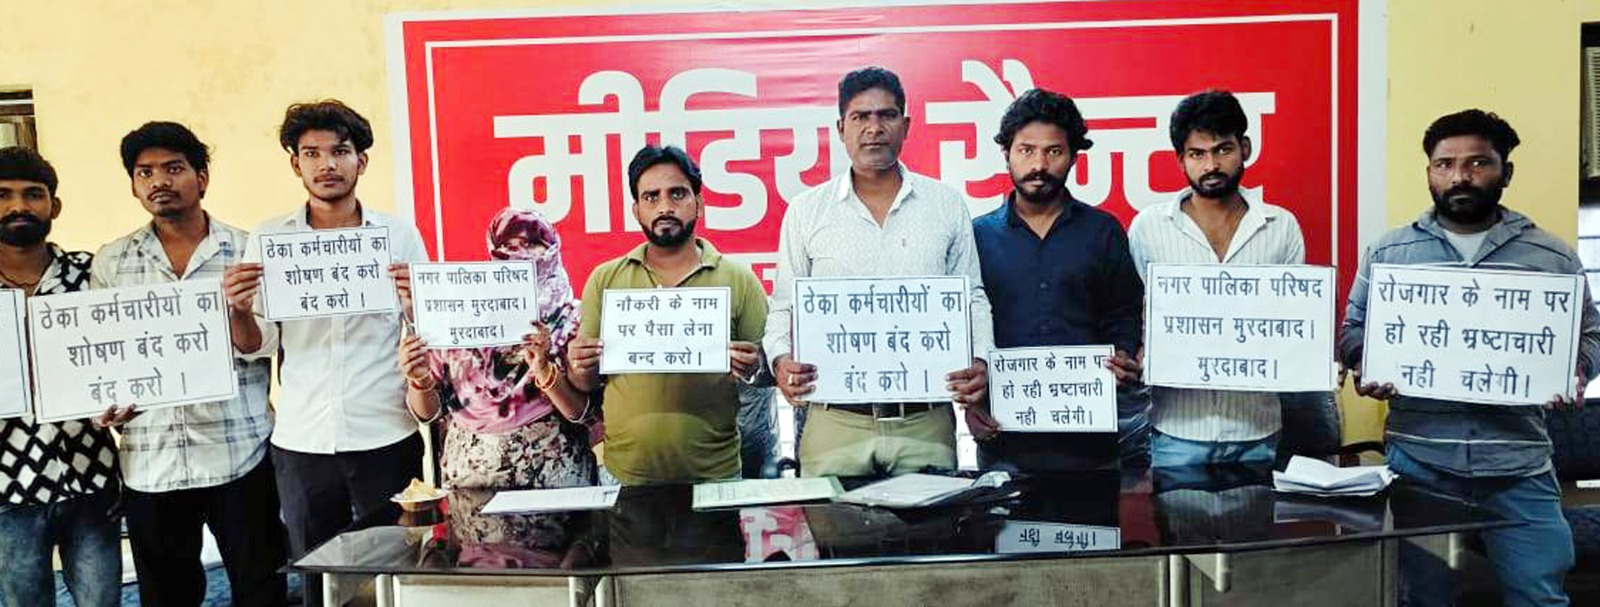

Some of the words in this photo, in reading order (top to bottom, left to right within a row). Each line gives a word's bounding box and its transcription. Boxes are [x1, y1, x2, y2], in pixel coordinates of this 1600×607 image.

[266, 239, 292, 258] ठेका
[300, 233, 362, 256] कर्मचारीयों
[370, 237, 386, 251] का
[284, 264, 323, 285] शोषण
[331, 263, 349, 282] बंद
[356, 258, 379, 279] करो
[418, 272, 439, 284] नगर
[447, 267, 486, 284] पालिका
[493, 266, 528, 283] परिषद
[1157, 276, 1191, 294] नगर
[1201, 271, 1260, 296] पालिका
[1270, 272, 1323, 298] परिषद
[300, 292, 318, 311] बंद
[325, 288, 348, 309] करो
[425, 299, 465, 314] प्रशासन
[617, 295, 660, 311] नौकरी
[669, 294, 682, 309] के
[691, 298, 718, 309] नाम
[803, 286, 838, 315] ठेका
[847, 284, 930, 314] कर्मचारीयों
[940, 291, 962, 312] का
[1378, 274, 1450, 305] रोजगार
[1462, 278, 1480, 307] के
[1494, 288, 1532, 310] नाम
[1544, 291, 1571, 313] पर
[40, 302, 78, 329] ठेका
[90, 288, 182, 324] कर्मचारीयों
[195, 291, 218, 312] का
[618, 325, 636, 336] पर
[645, 320, 674, 336] पैसा
[683, 319, 713, 336] लेना
[827, 324, 877, 353] शोषण
[886, 325, 910, 353] बंद
[920, 322, 951, 351] करो
[1164, 316, 1223, 335] प्रशासन
[1384, 315, 1405, 344] हो
[1418, 319, 1451, 348] रही
[67, 336, 125, 366] शोषण
[135, 331, 163, 358] बंद
[173, 323, 208, 353] करो
[628, 352, 655, 365] बन्द
[994, 355, 1038, 373] रोजगार
[1045, 352, 1056, 370] के
[1064, 356, 1086, 370] नाम
[89, 376, 117, 403] बंद
[128, 367, 162, 398] करो
[844, 365, 867, 392] बंद
[878, 362, 908, 391] करो
[1401, 360, 1436, 388] नही
[1002, 380, 1014, 399] हो
[1022, 379, 1041, 398] रही
[1015, 406, 1036, 425] नही
